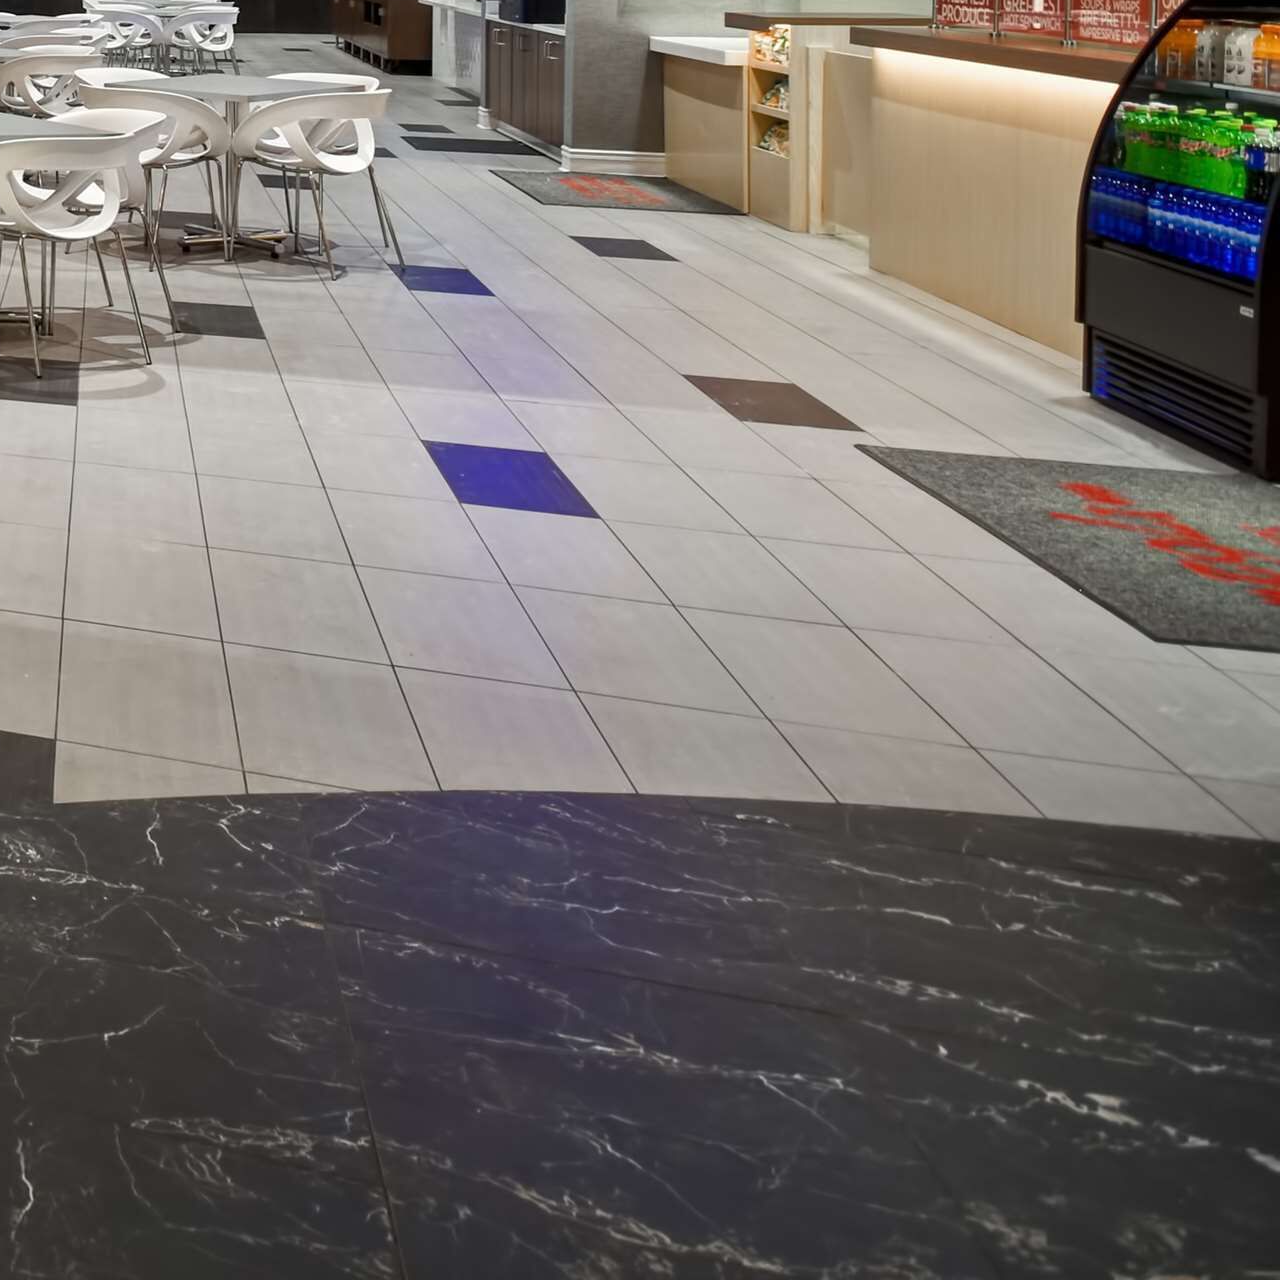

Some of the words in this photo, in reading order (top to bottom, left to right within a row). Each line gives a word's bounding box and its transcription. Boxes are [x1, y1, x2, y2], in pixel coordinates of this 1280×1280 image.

[941, 4, 991, 25] PRODUCE
[1105, 0, 1112, 11] &
[1113, 0, 1140, 13] WRAPS
[1003, 14, 1019, 26] HOT
[1080, 12, 1101, 26] ARE
[1101, 13, 1140, 29] PRETTY
[1079, 27, 1120, 41] IMPRESSIVE
[1122, 30, 1140, 44] TOO
